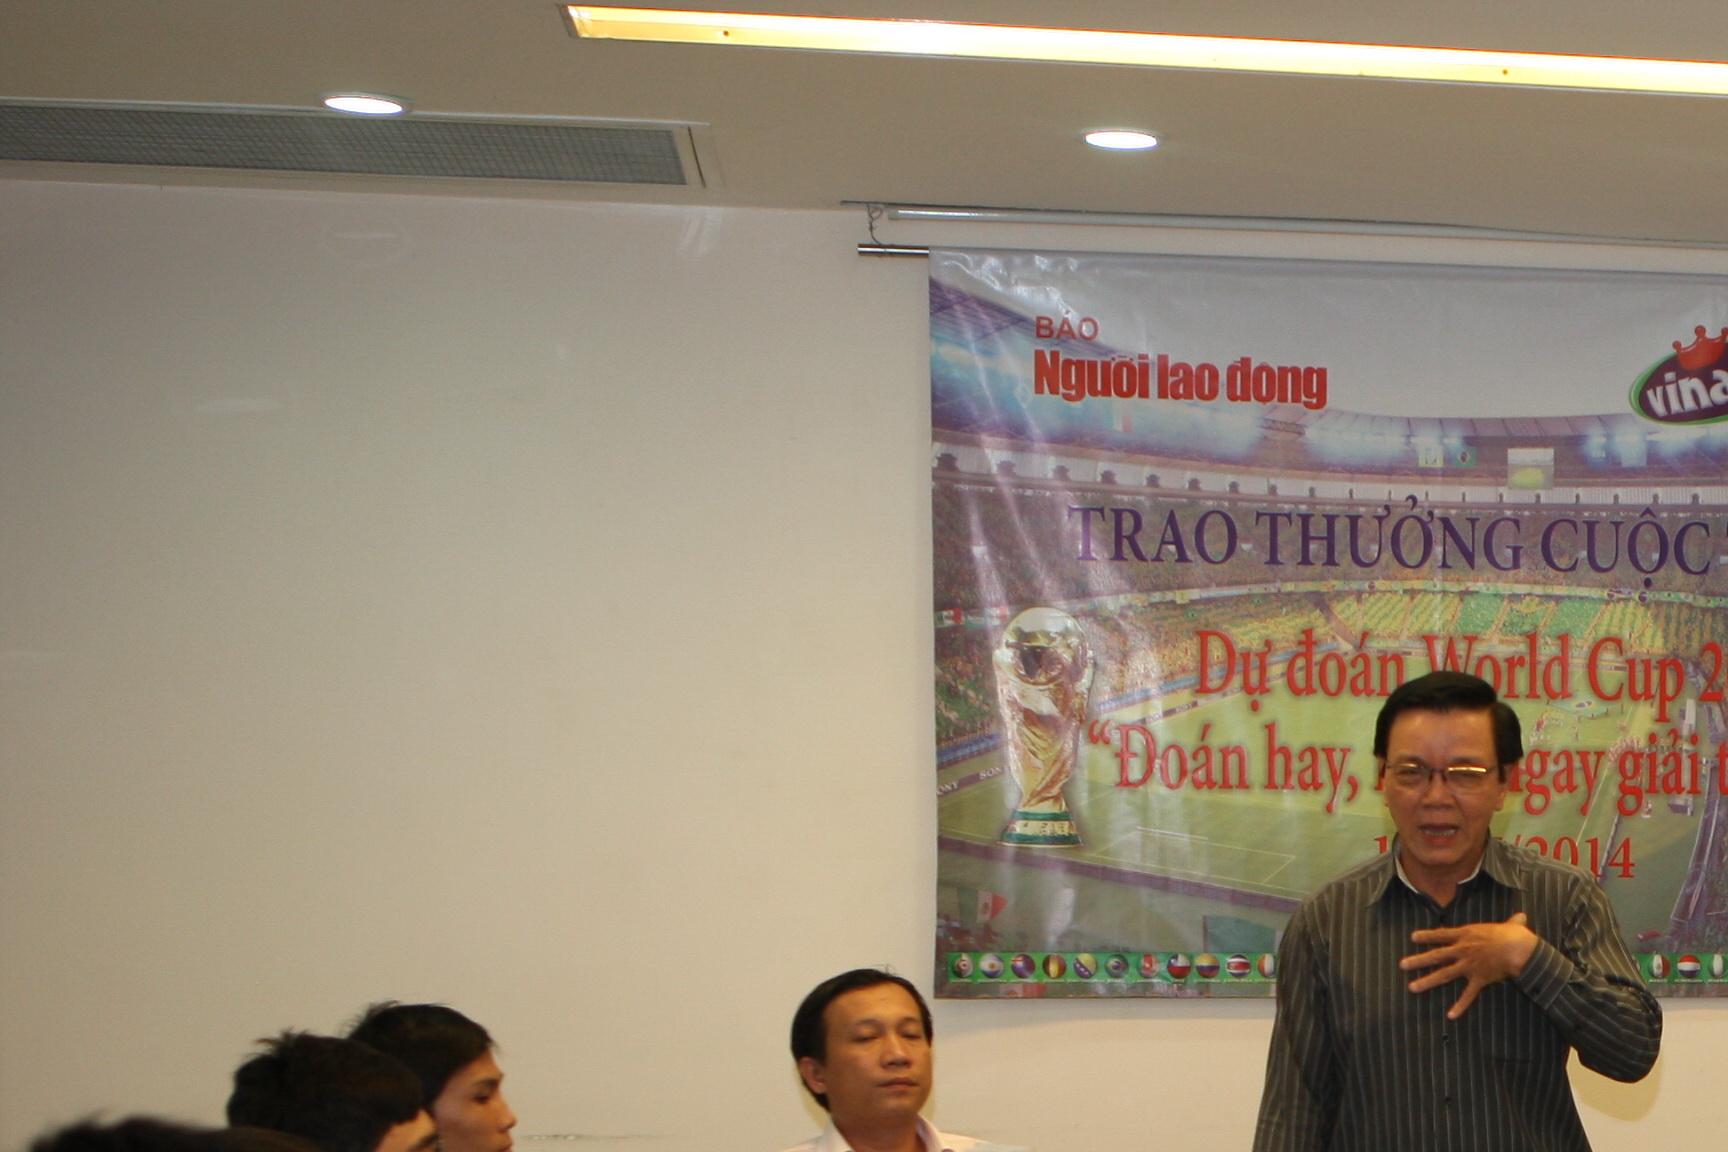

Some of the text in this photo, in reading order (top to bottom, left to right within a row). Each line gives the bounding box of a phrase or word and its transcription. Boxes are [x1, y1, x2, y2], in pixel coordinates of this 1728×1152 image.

[1157, 353, 1220, 402] lao
[1226, 356, 1328, 411] động
[1068, 505, 1239, 566] TRAO
[1255, 494, 1526, 571] THƯỞNG
[1541, 507, 1711, 589] CUỘC
[1195, 629, 1272, 712] Dự
[1286, 628, 1404, 698] đoán
[1422, 632, 1573, 699] World
[1587, 636, 1686, 723] Cup
[1264, 721, 1360, 814] hay,
[1616, 728, 1700, 817] giải
